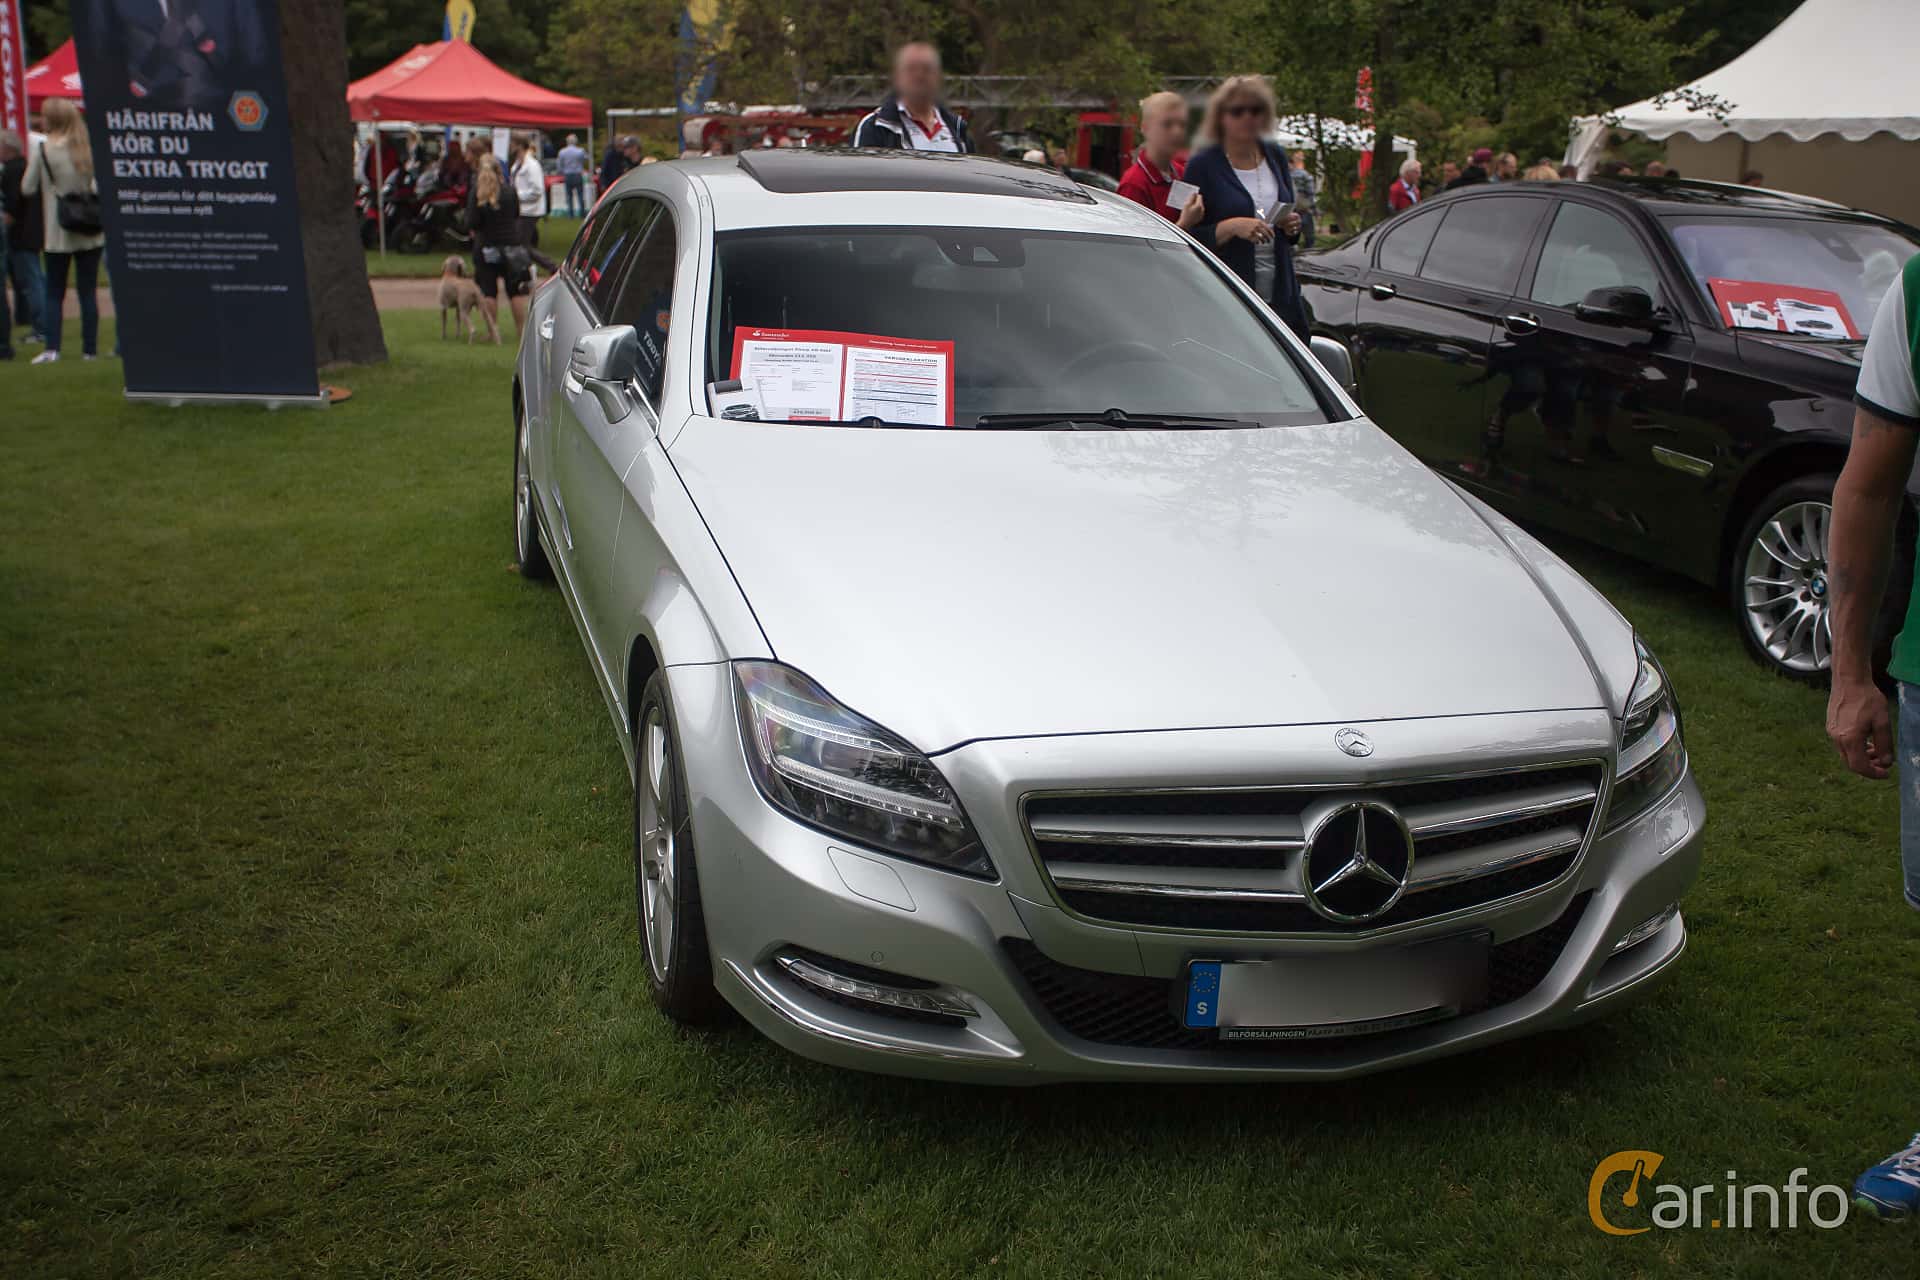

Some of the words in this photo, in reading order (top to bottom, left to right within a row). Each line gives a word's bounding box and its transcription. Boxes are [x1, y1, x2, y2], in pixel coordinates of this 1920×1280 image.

[106, 108, 214, 131] HÄRIFRÅN
[110, 132, 155, 154] KÖR
[160, 135, 190, 154] DU
[113, 159, 183, 178] EXTRA
[186, 160, 269, 179] TRYGGT
[1196, 1002, 1208, 1015] S
